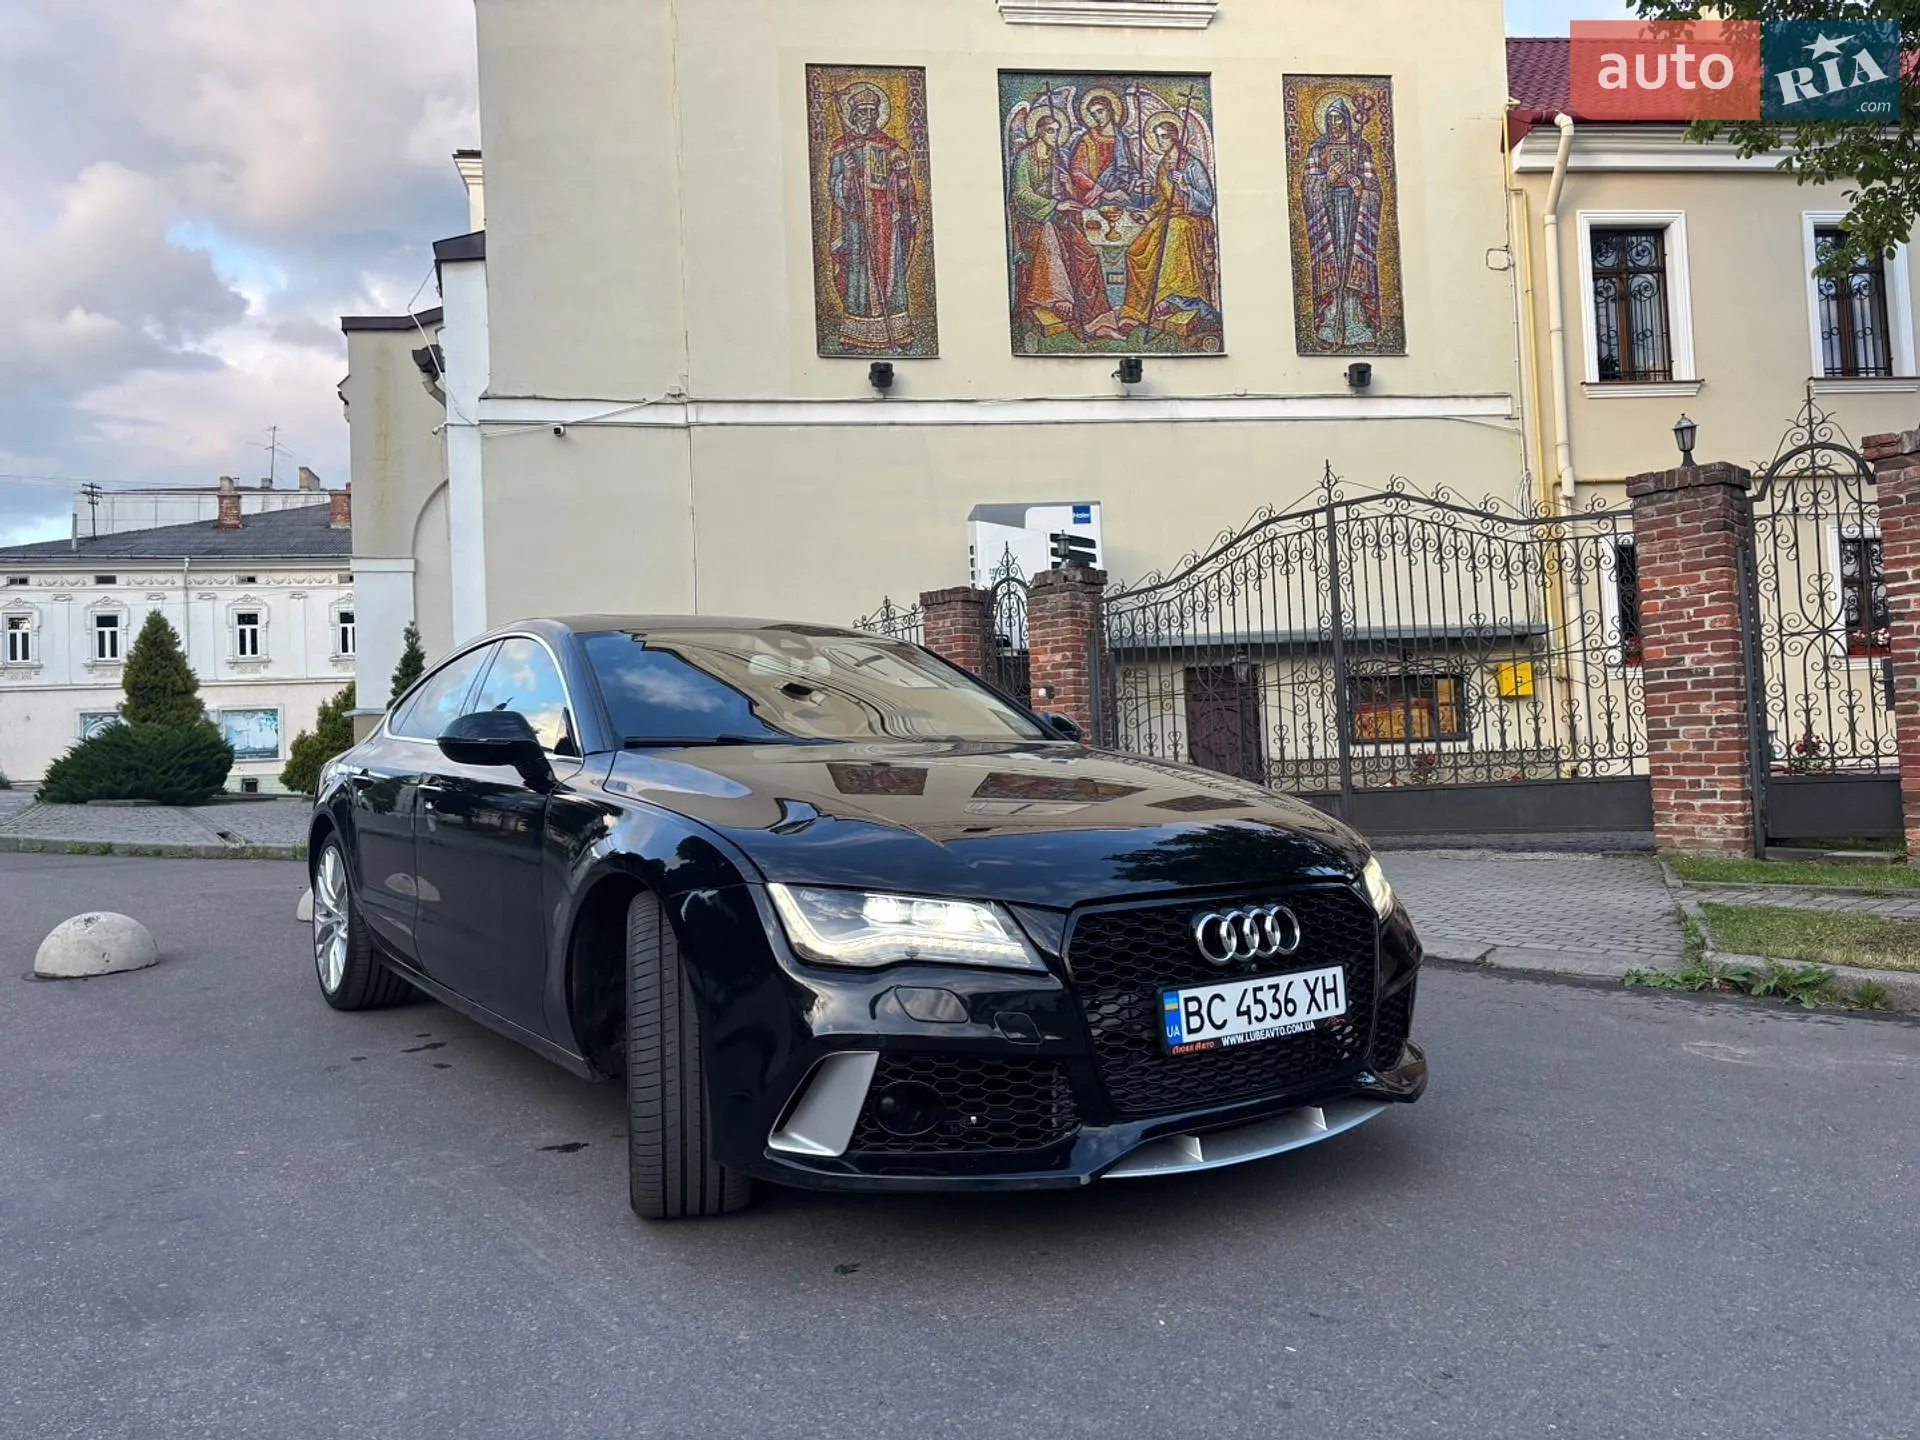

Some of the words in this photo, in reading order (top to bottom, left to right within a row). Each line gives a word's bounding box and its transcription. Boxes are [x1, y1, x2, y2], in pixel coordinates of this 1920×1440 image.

[1183, 993, 1228, 1035] BC
[1236, 981, 1297, 1025] 4536
[1303, 974, 1340, 1015] XH
[1166, 1025, 1181, 1038] UA
[1221, 1020, 1316, 1047] WWW.LUBEAVTO.COM.UA
